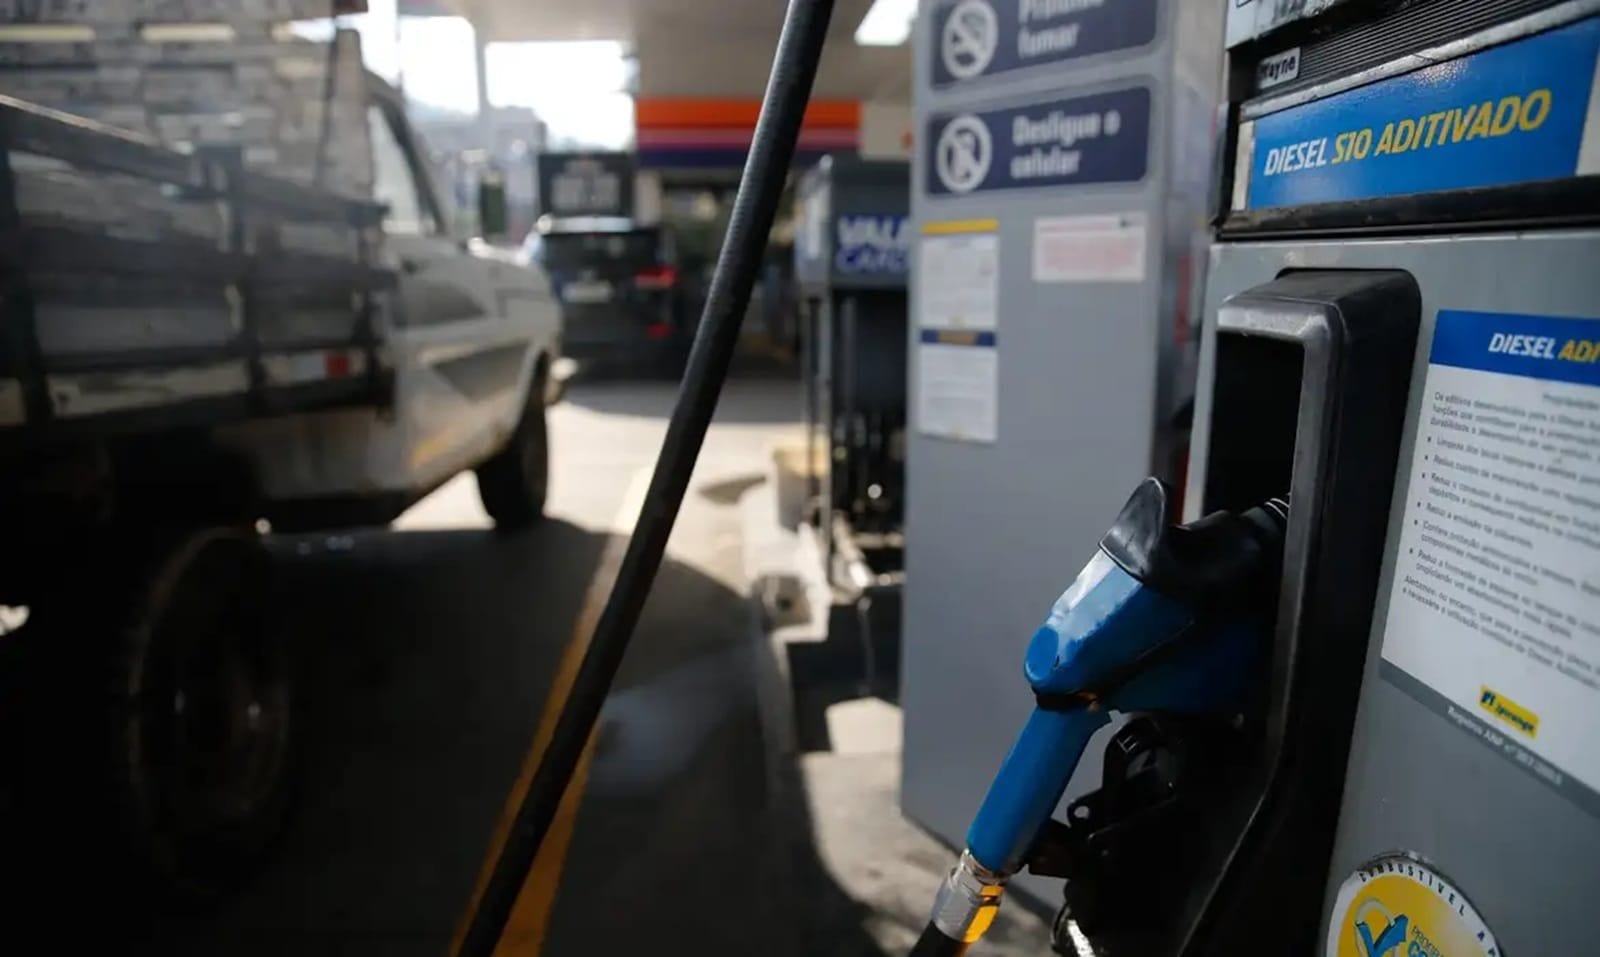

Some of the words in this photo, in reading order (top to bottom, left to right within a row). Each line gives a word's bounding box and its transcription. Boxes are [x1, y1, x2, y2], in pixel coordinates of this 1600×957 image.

[1264, 138, 1327, 176] DIESEL
[1332, 128, 1373, 164] S10
[1374, 89, 1552, 157] ADITIVADO
[1488, 333, 1556, 359] DIESEL
